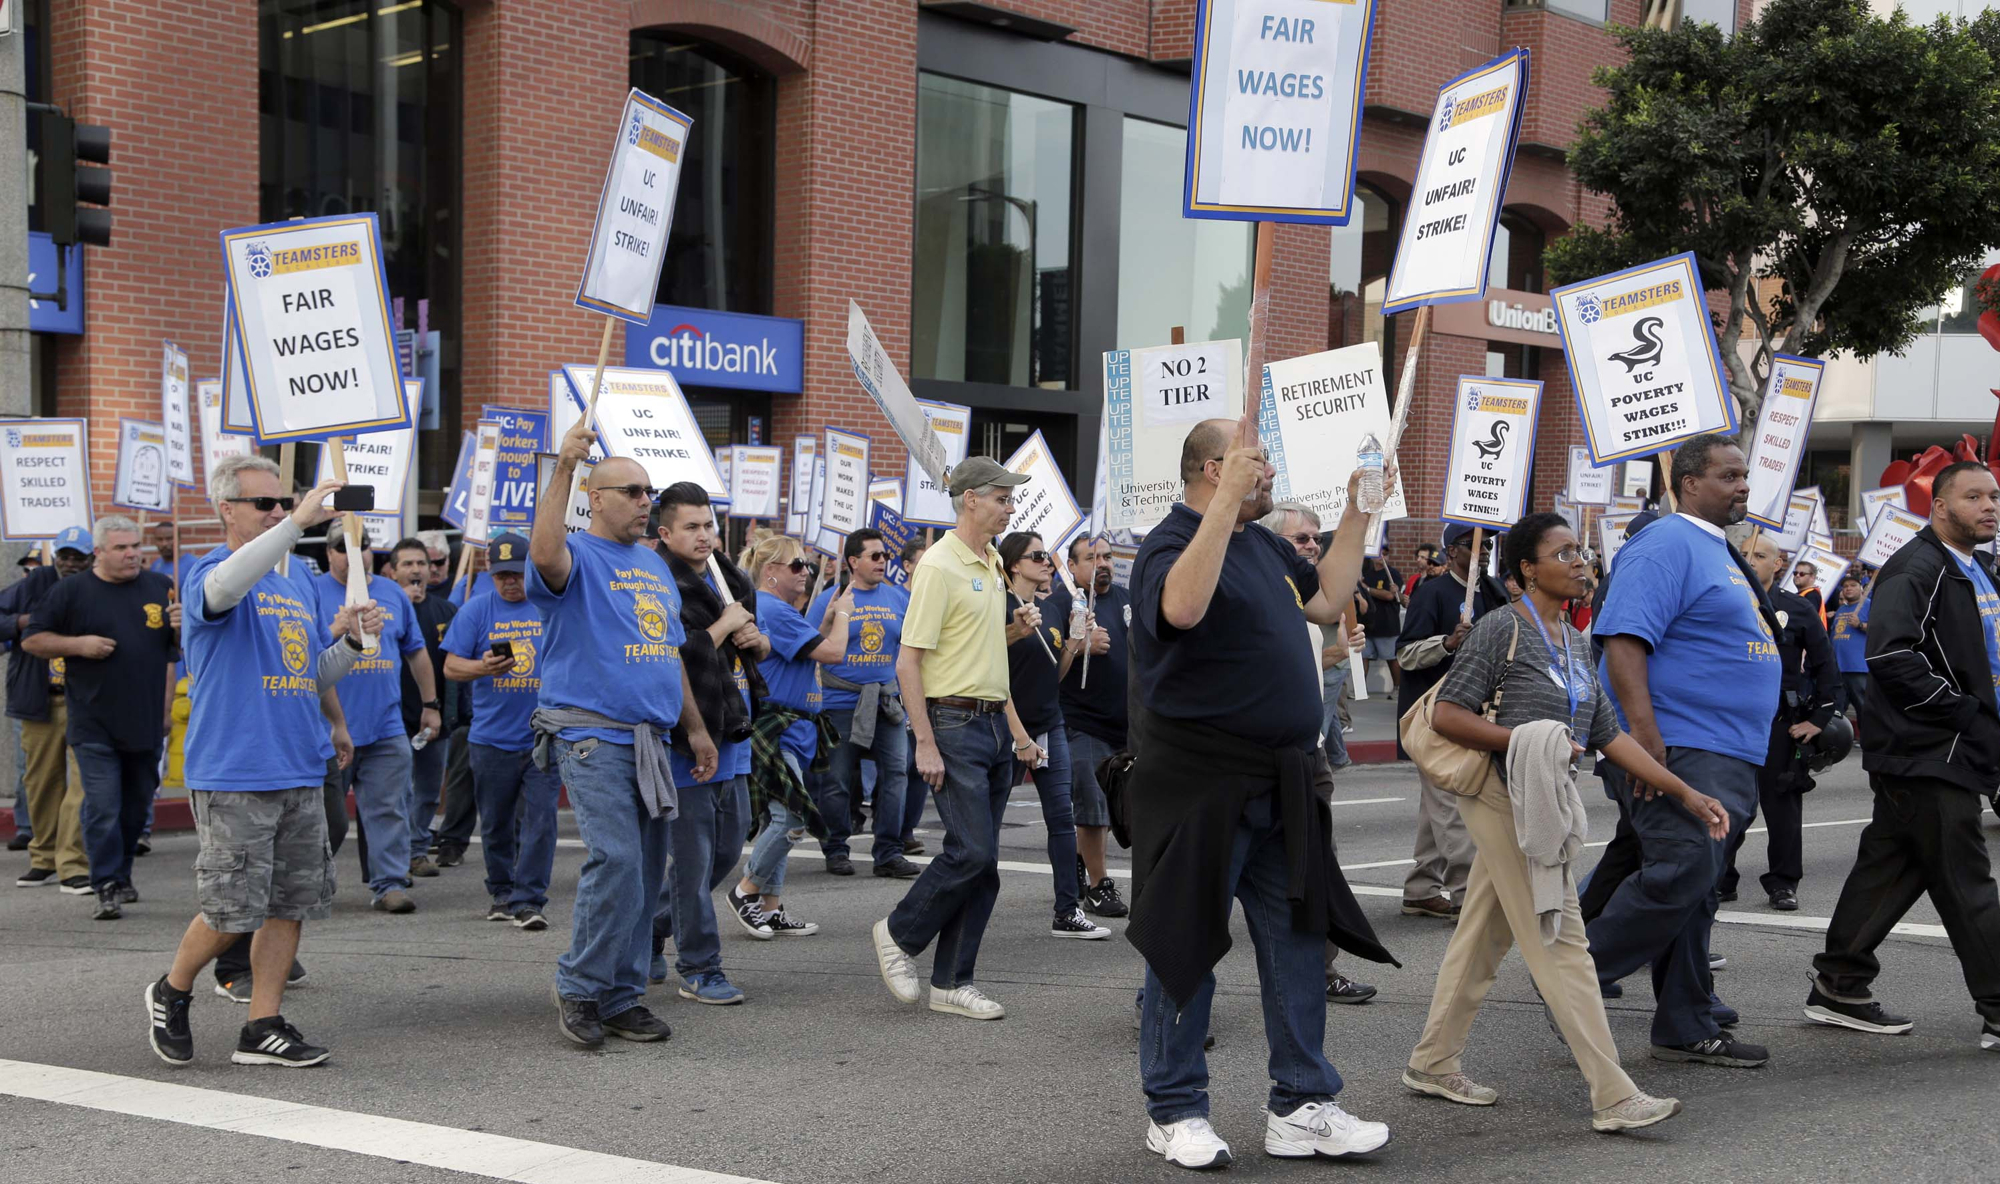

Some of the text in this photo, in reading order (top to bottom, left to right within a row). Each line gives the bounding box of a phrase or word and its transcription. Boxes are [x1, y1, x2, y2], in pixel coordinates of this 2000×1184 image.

[1261, 15, 1315, 44] FAIR
[1238, 69, 1324, 99] WAGES
[1454, 87, 1508, 117] TEAMSTERS
[641, 126, 680, 156] TEAMSTERS
[1241, 125, 1312, 153] NOW!
[1448, 147, 1467, 167] UC
[643, 168, 657, 189] UC
[1425, 177, 1477, 207] UNFAIR!
[620, 196, 658, 226] UNFAIR!
[1416, 214, 1468, 241] STRIKE!
[614, 230, 650, 258] STRIKE!
[273, 243, 358, 266] TEAMSTERS
[282, 288, 335, 314] FAIR
[1603, 281, 1680, 312] TEAMSTERS
[1489, 299, 1560, 334] UnionB
[273, 327, 360, 357] WAGES
[649, 330, 778, 376] citibank
[1107, 351, 1129, 364] UP
[1108, 363, 1130, 375] TE
[1161, 356, 1207, 379] NO 2
[289, 367, 360, 397] NOW!
[1108, 377, 1130, 389] UP
[1281, 368, 1374, 403] RETIREMENT
[1633, 371, 1654, 385] UC
[610, 382, 668, 393] TEAMSTERS
[1109, 389, 1130, 400] TE
[1610, 382, 1685, 408] POVERTY
[1159, 384, 1211, 407] TIER
[1481, 396, 1528, 410] TEAMSTERS
[632, 409, 654, 419] UC
[1109, 403, 1131, 415] UP
[1296, 393, 1366, 421] SECURITY
[1623, 402, 1679, 423] WAGES
[515, 416, 536, 434] Pay
[932, 417, 963, 430] TEAMSTERS
[1110, 414, 1131, 426] TE
[1768, 411, 1799, 427] RESPECT
[622, 428, 682, 440] UNFAIR!
[1110, 427, 1131, 439] UP
[1260, 431, 1280, 443] UP
[1623, 418, 1687, 442] STINK!!!
[1110, 439, 1132, 450] TE
[1763, 433, 1791, 450] SKILLED
[495, 451, 535, 468] nough
[633, 447, 691, 459] STRIKE!
[1110, 452, 1132, 465] UP
[16, 456, 67, 468] RESPECT
[347, 463, 389, 476] TRIKE!
[840, 459, 852, 468] OUR
[1481, 461, 1493, 471] UC
[1758, 456, 1786, 474] TRADES!
[507, 465, 522, 479] to
[837, 472, 853, 483] WORK
[1111, 464, 1132, 476] TE
[20, 477, 66, 488] SKILLED
[1121, 480, 1177, 495] University
[1463, 474, 1507, 487] POVERTY
[490, 480, 536, 508] LIVE
[836, 486, 854, 497] MAKES
[869, 489, 897, 498] EAMSTERS
[1016, 487, 1030, 504] UC
[1121, 490, 1185, 508] & Technical
[1468, 489, 1499, 501] WAGES
[20, 497, 71, 508] TRADES!
[834, 499, 853, 511] THE UC
[1012, 489, 1048, 530] UNFAIR!
[1308, 498, 1342, 513] chnical
[1462, 502, 1500, 516] STINK!!!
[882, 510, 896, 525] UC:
[1121, 508, 1146, 517] CWA
[878, 519, 907, 546] Worker
[1884, 532, 1903, 544] FAIR
[880, 530, 902, 556] noug
[615, 568, 632, 580] Pay
[886, 559, 906, 585] VE
[609, 580, 645, 592] Enough
[646, 582, 655, 591] to
[850, 612, 874, 621] nough
[494, 621, 510, 630] Pay
[488, 629, 522, 640] Enough
[522, 629, 532, 637] to
[623, 644, 681, 659] TEAMSTER
[262, 676, 318, 692] TEAMSTE
[492, 678, 544, 688] TEAMSTE
